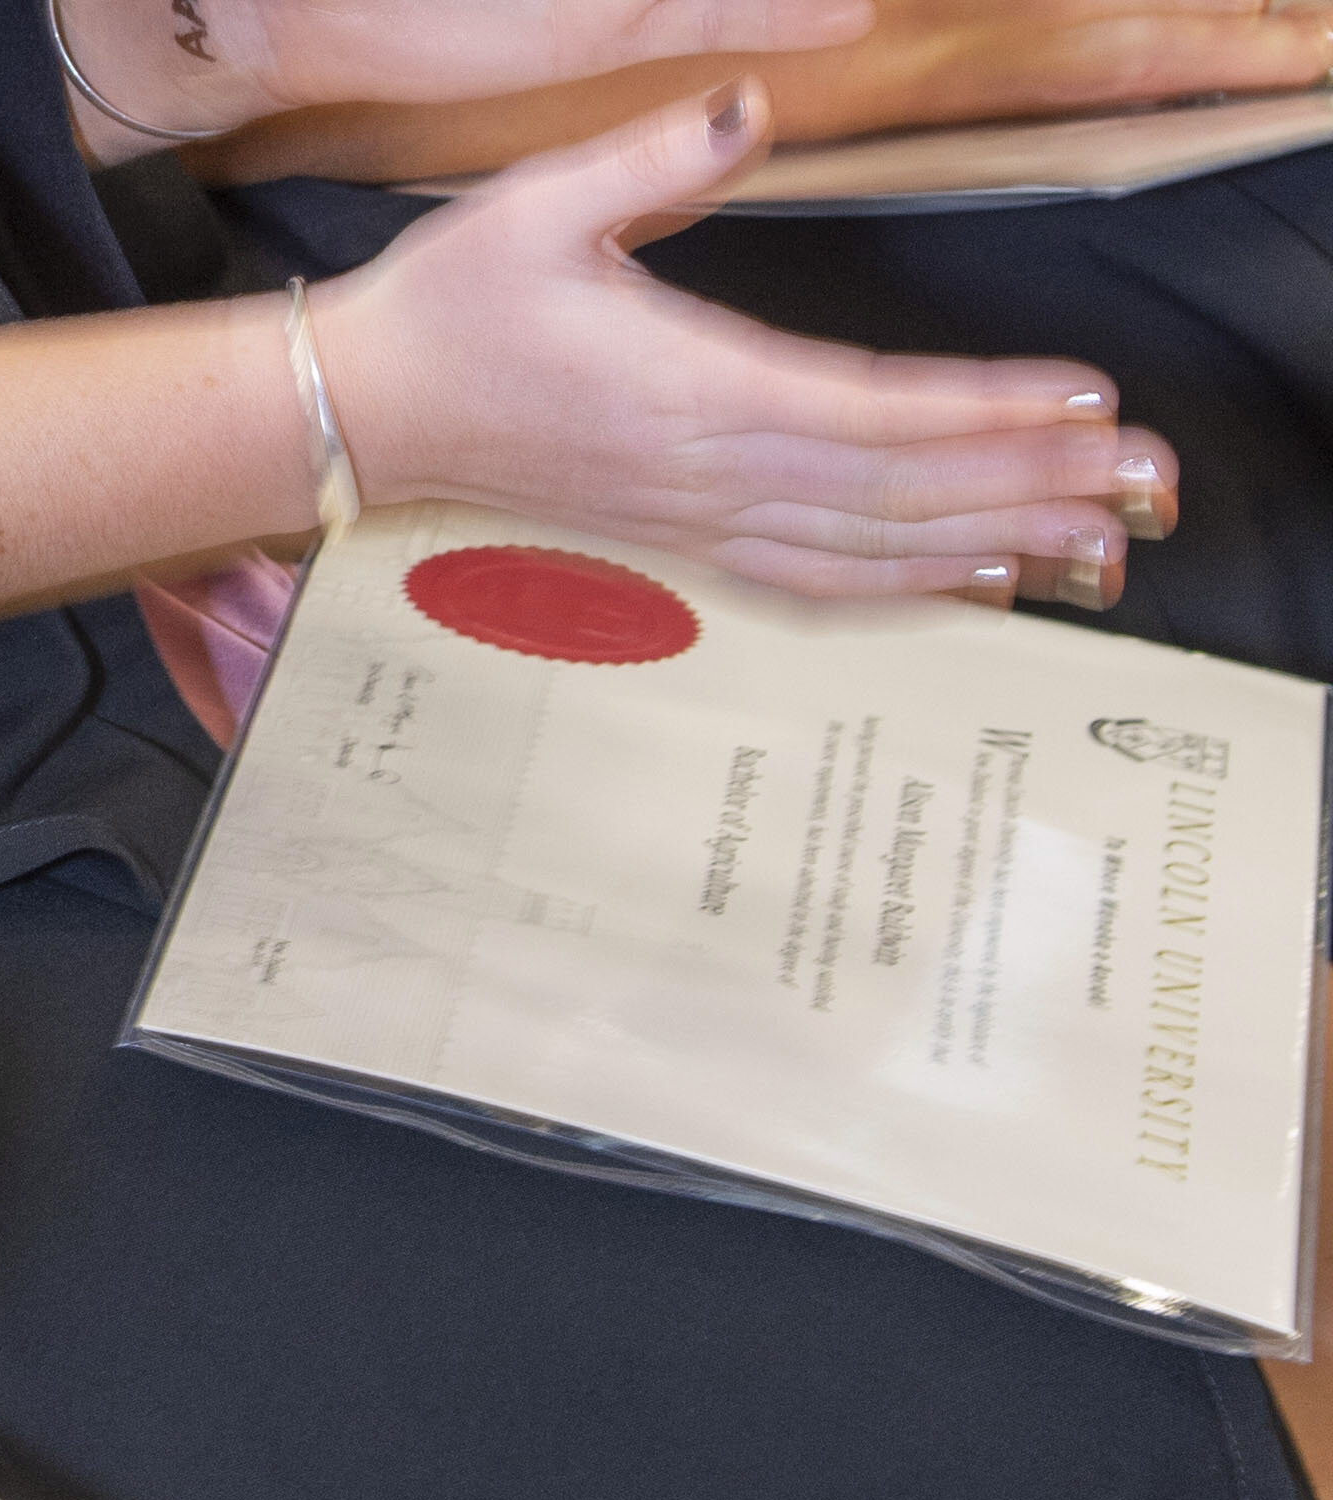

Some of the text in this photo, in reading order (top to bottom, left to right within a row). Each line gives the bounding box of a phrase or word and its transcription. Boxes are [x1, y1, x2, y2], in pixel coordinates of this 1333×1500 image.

[697, 746, 767, 917] Bachelor of Agriculture
[1136, 780, 1217, 1181] LINCOLN UNIVERSITY
